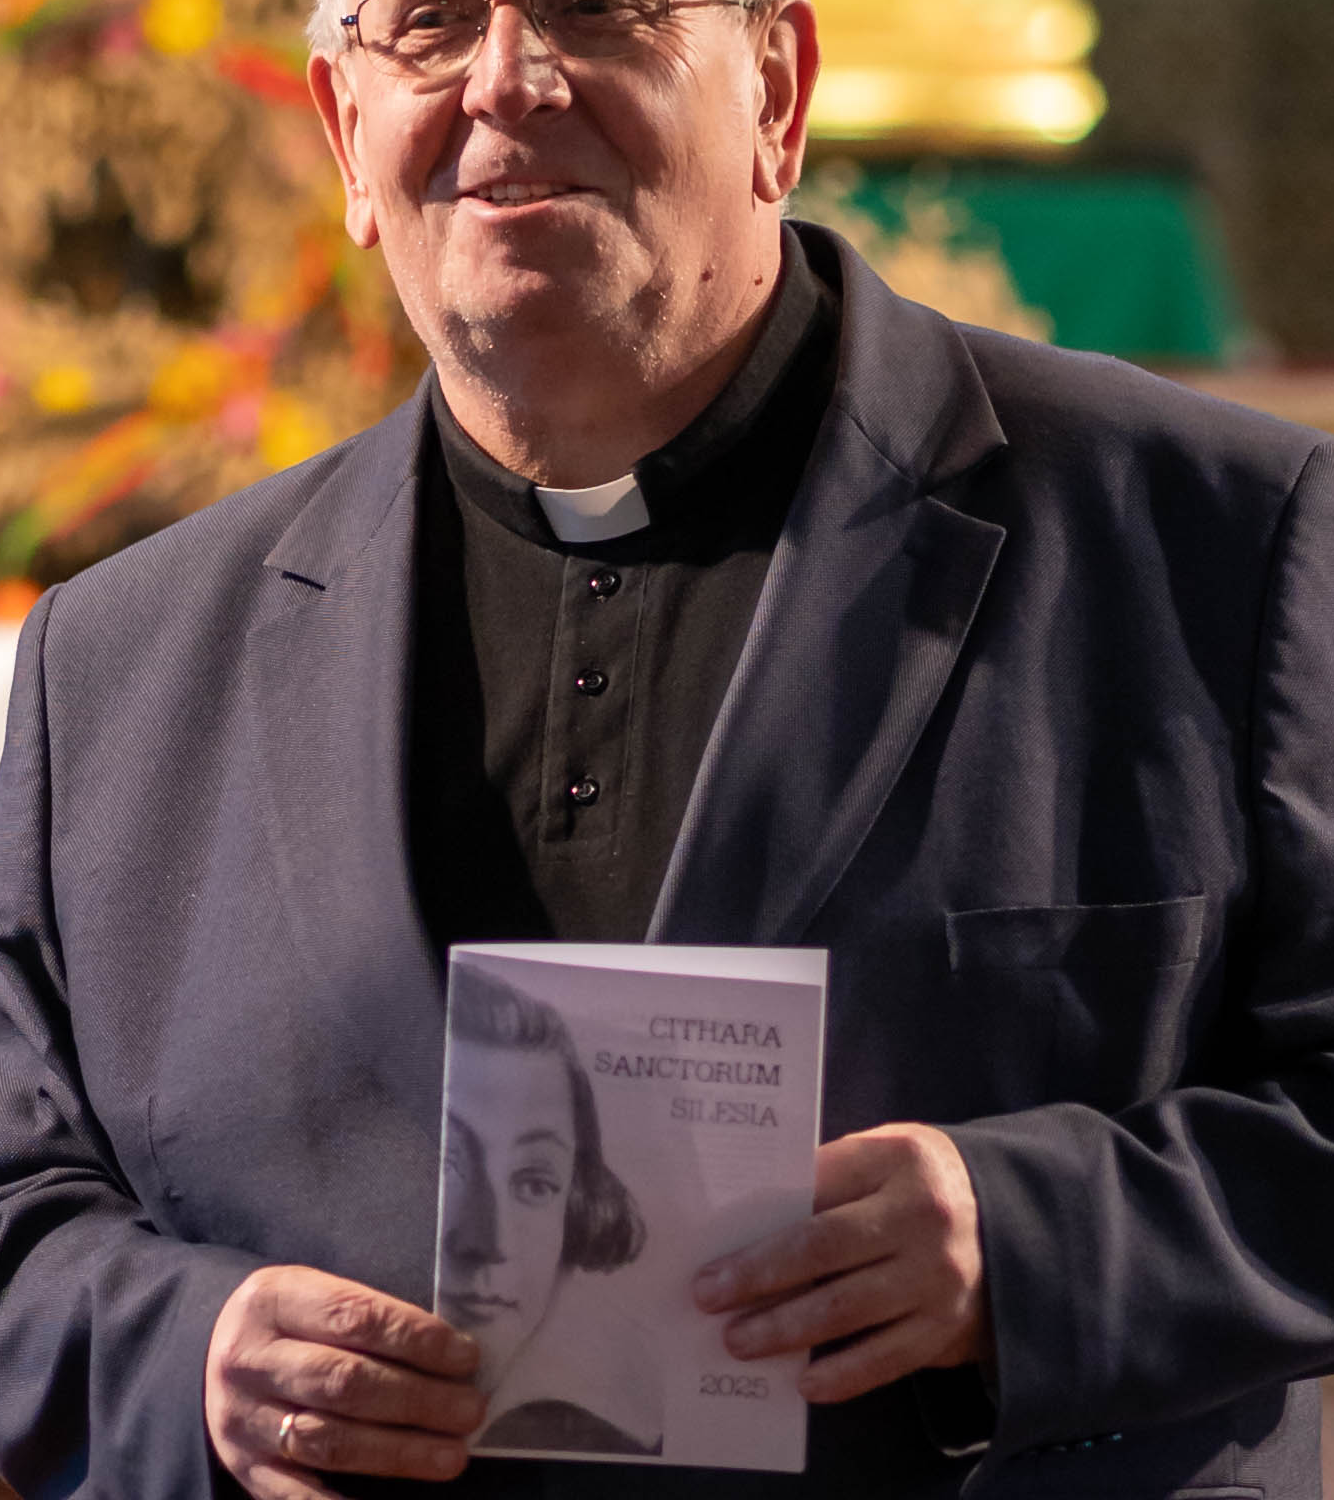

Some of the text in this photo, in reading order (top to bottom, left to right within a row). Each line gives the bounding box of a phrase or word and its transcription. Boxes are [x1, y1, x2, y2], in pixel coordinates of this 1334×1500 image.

[649, 1016, 782, 1049] CITHARA
[594, 1051, 782, 1087] SANCTORUM
[670, 1097, 779, 1128] SILESIA
[699, 1373, 770, 1400] 2025
